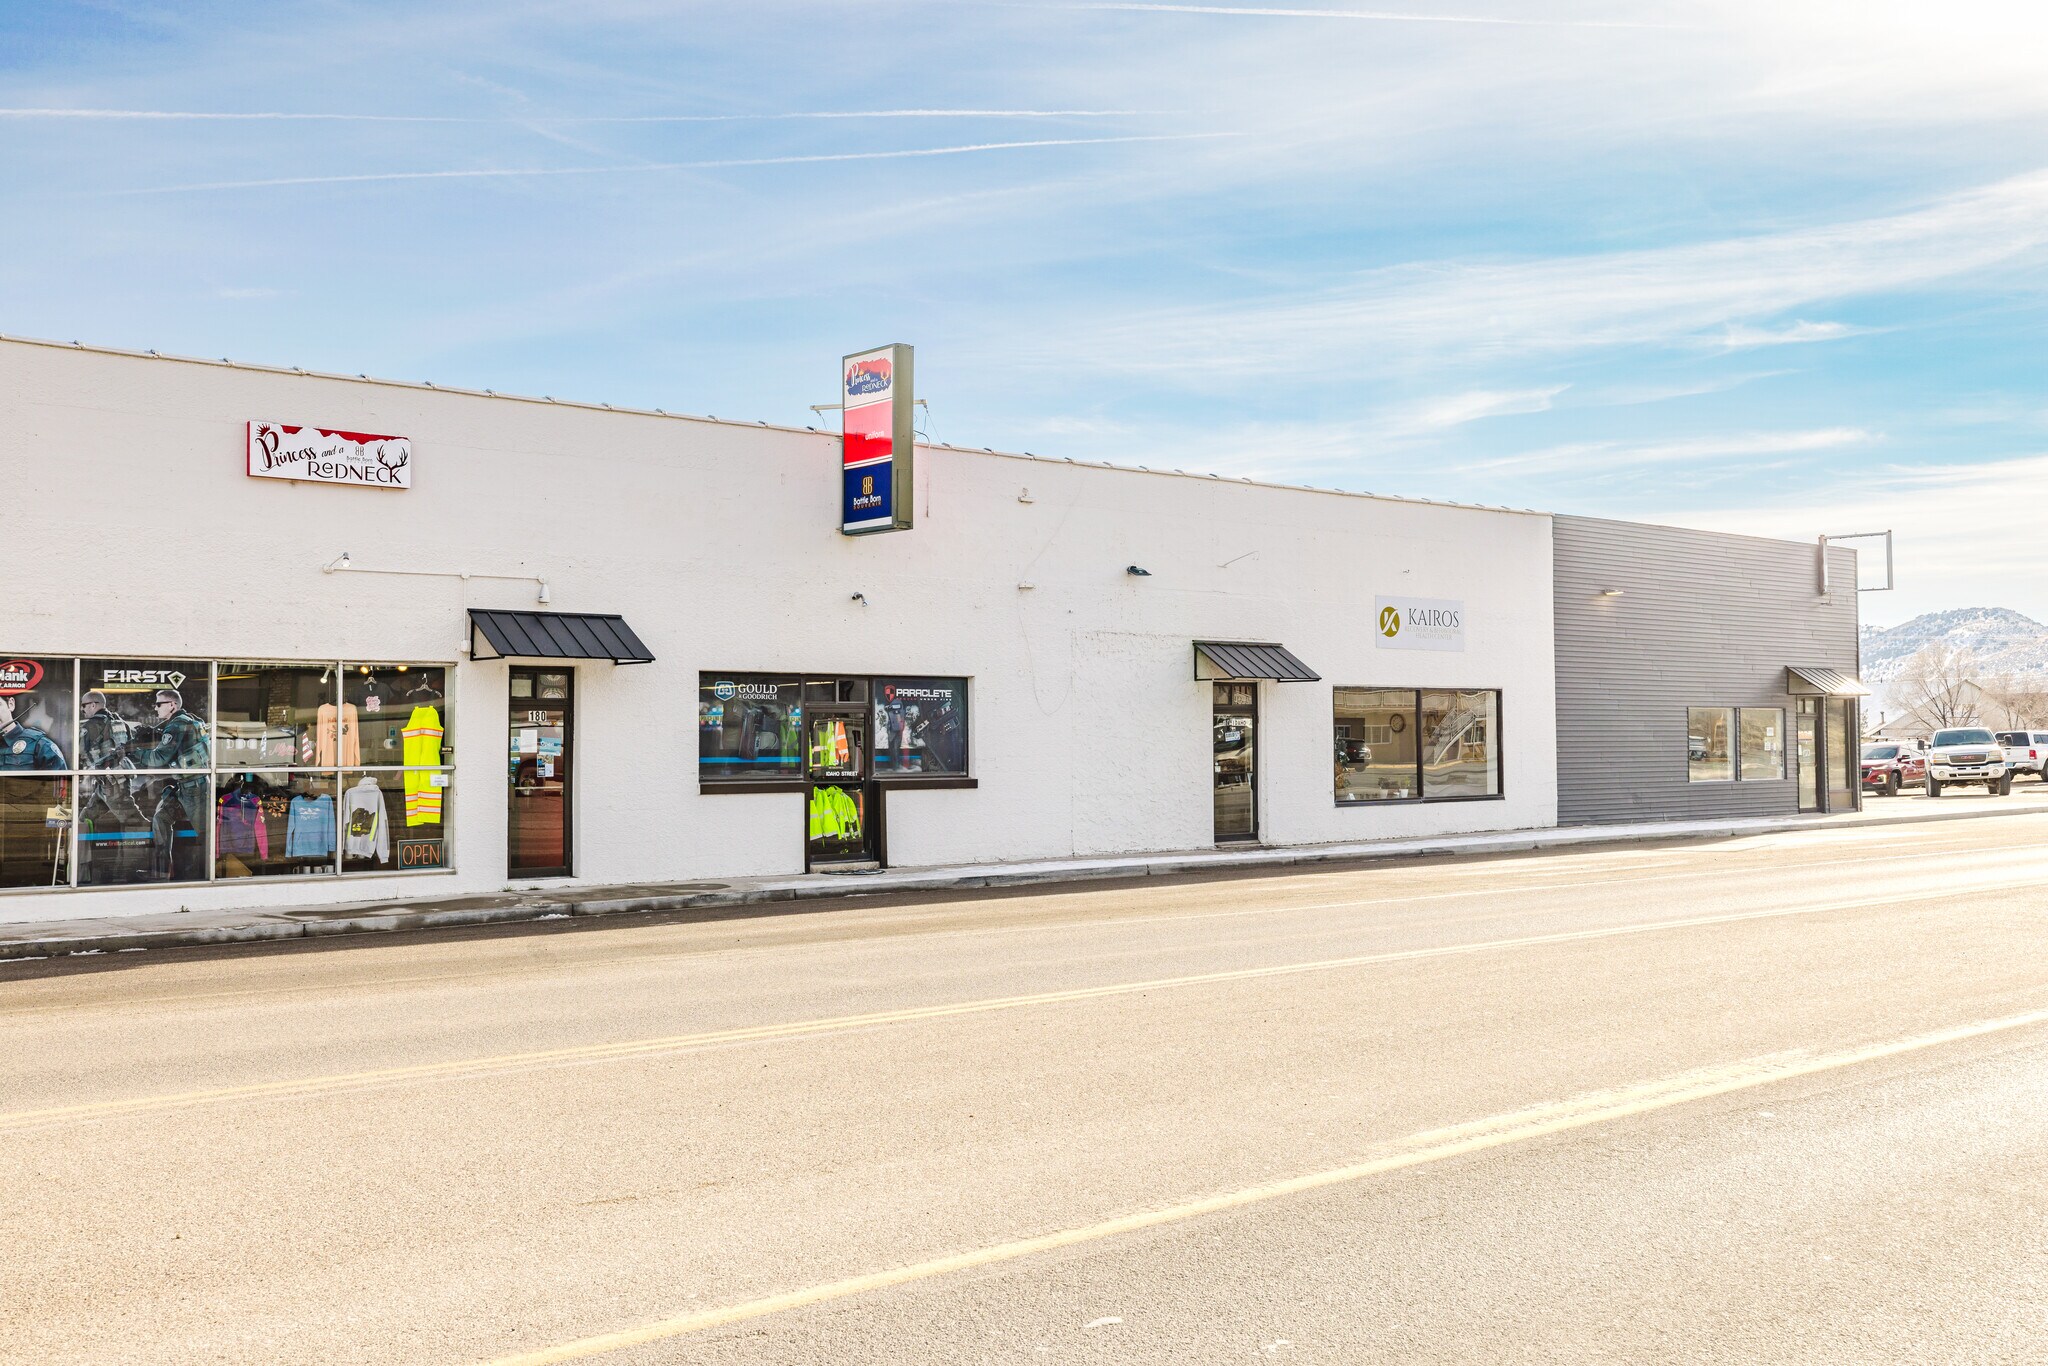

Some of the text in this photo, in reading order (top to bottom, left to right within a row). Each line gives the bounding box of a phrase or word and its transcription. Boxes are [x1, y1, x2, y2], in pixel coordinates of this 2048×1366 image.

[255, 431, 317, 472] Princess
[321, 445, 336, 458] and
[1408, 608, 1460, 628] KAIROS
[0, 669, 29, 681] lank
[738, 683, 778, 694] GOULD
[896, 688, 953, 698] PARACLETE
[529, 711, 546, 721] 180
[402, 844, 440, 866] OPEN
